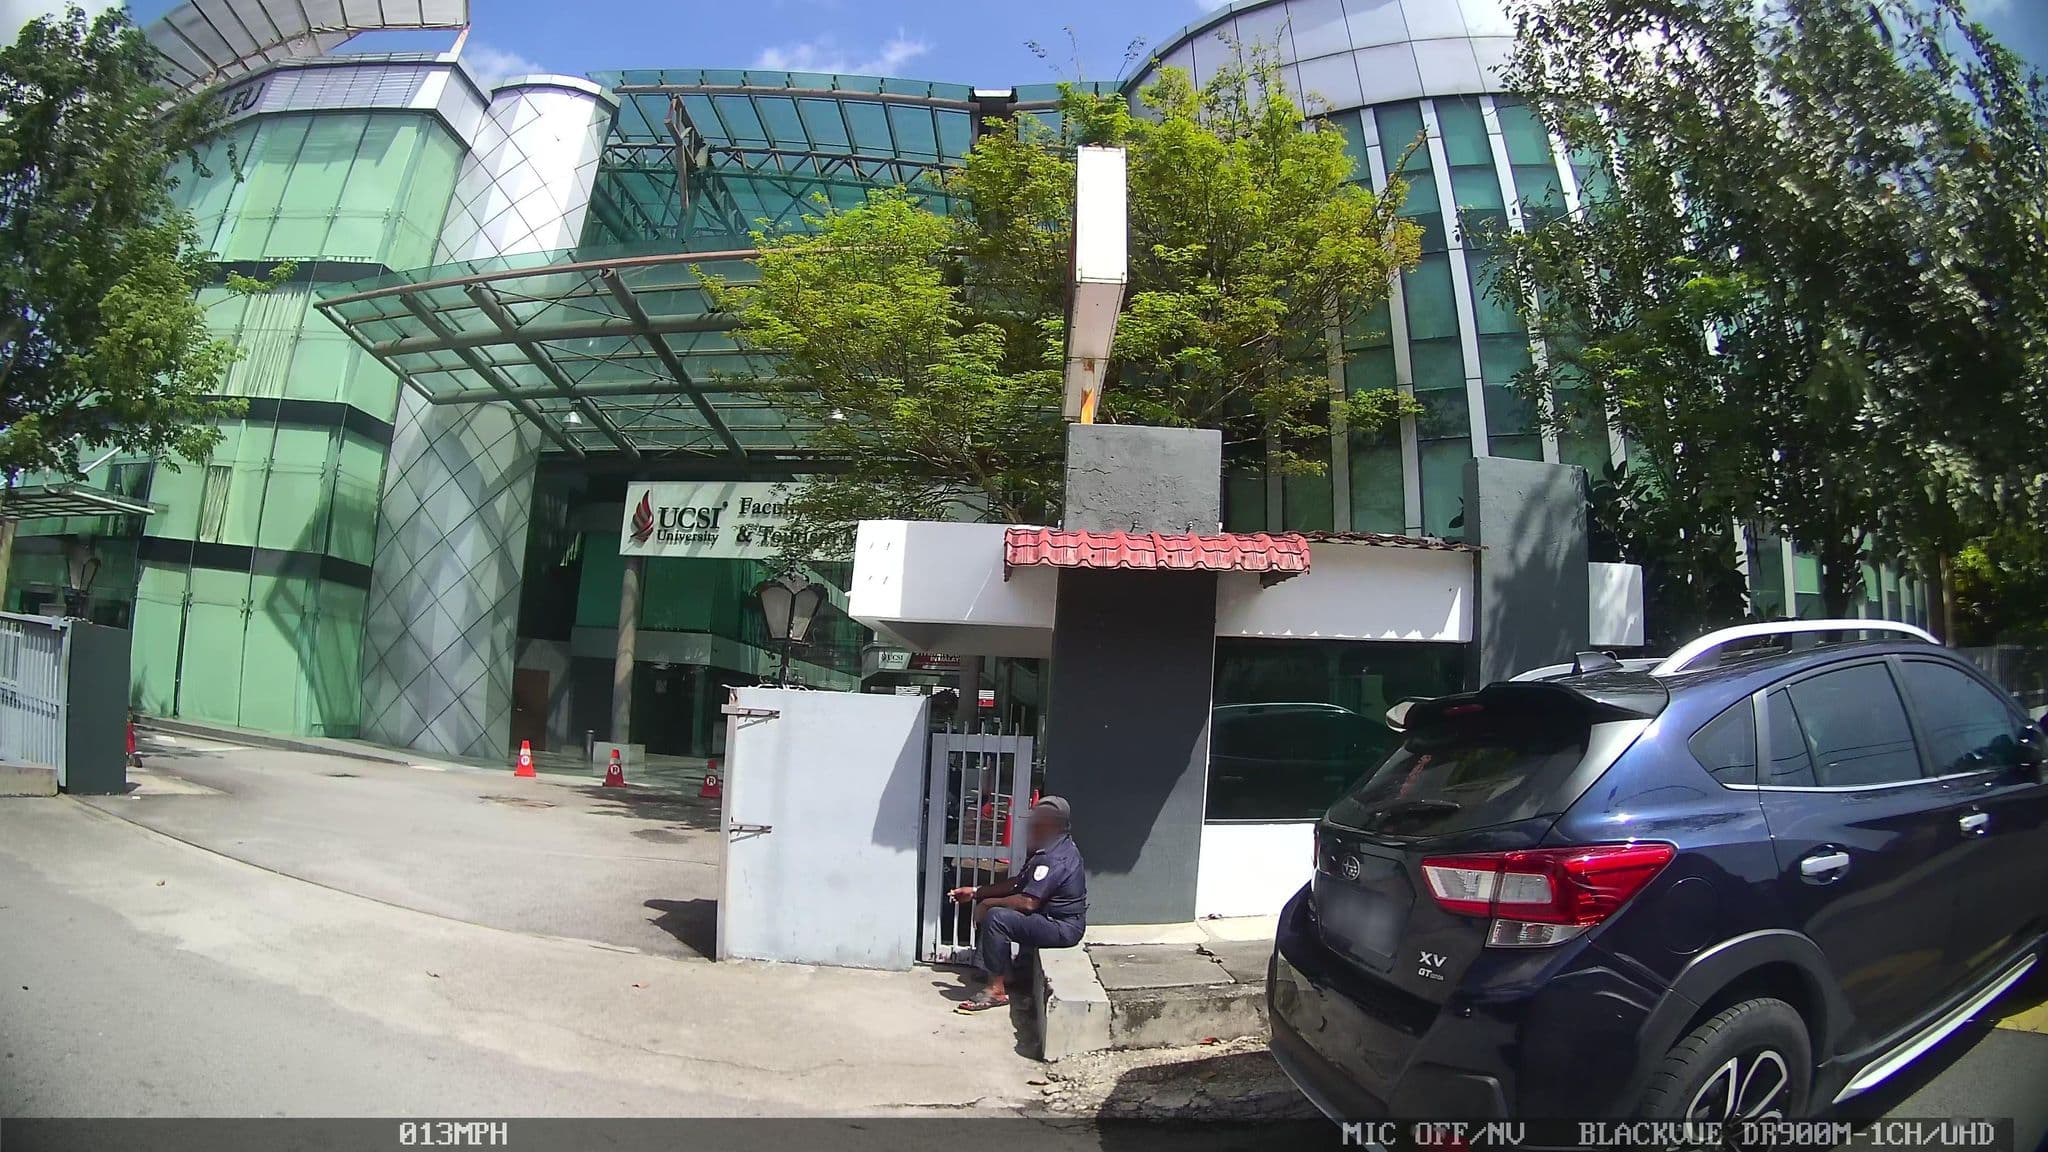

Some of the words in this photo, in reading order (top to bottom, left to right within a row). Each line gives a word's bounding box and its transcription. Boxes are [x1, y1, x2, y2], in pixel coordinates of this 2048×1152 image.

[658, 506, 722, 529] UCSI
[657, 528, 719, 548] University
[736, 525, 753, 543] &
[1419, 950, 1448, 968] XV
[1418, 967, 1433, 978] GT
